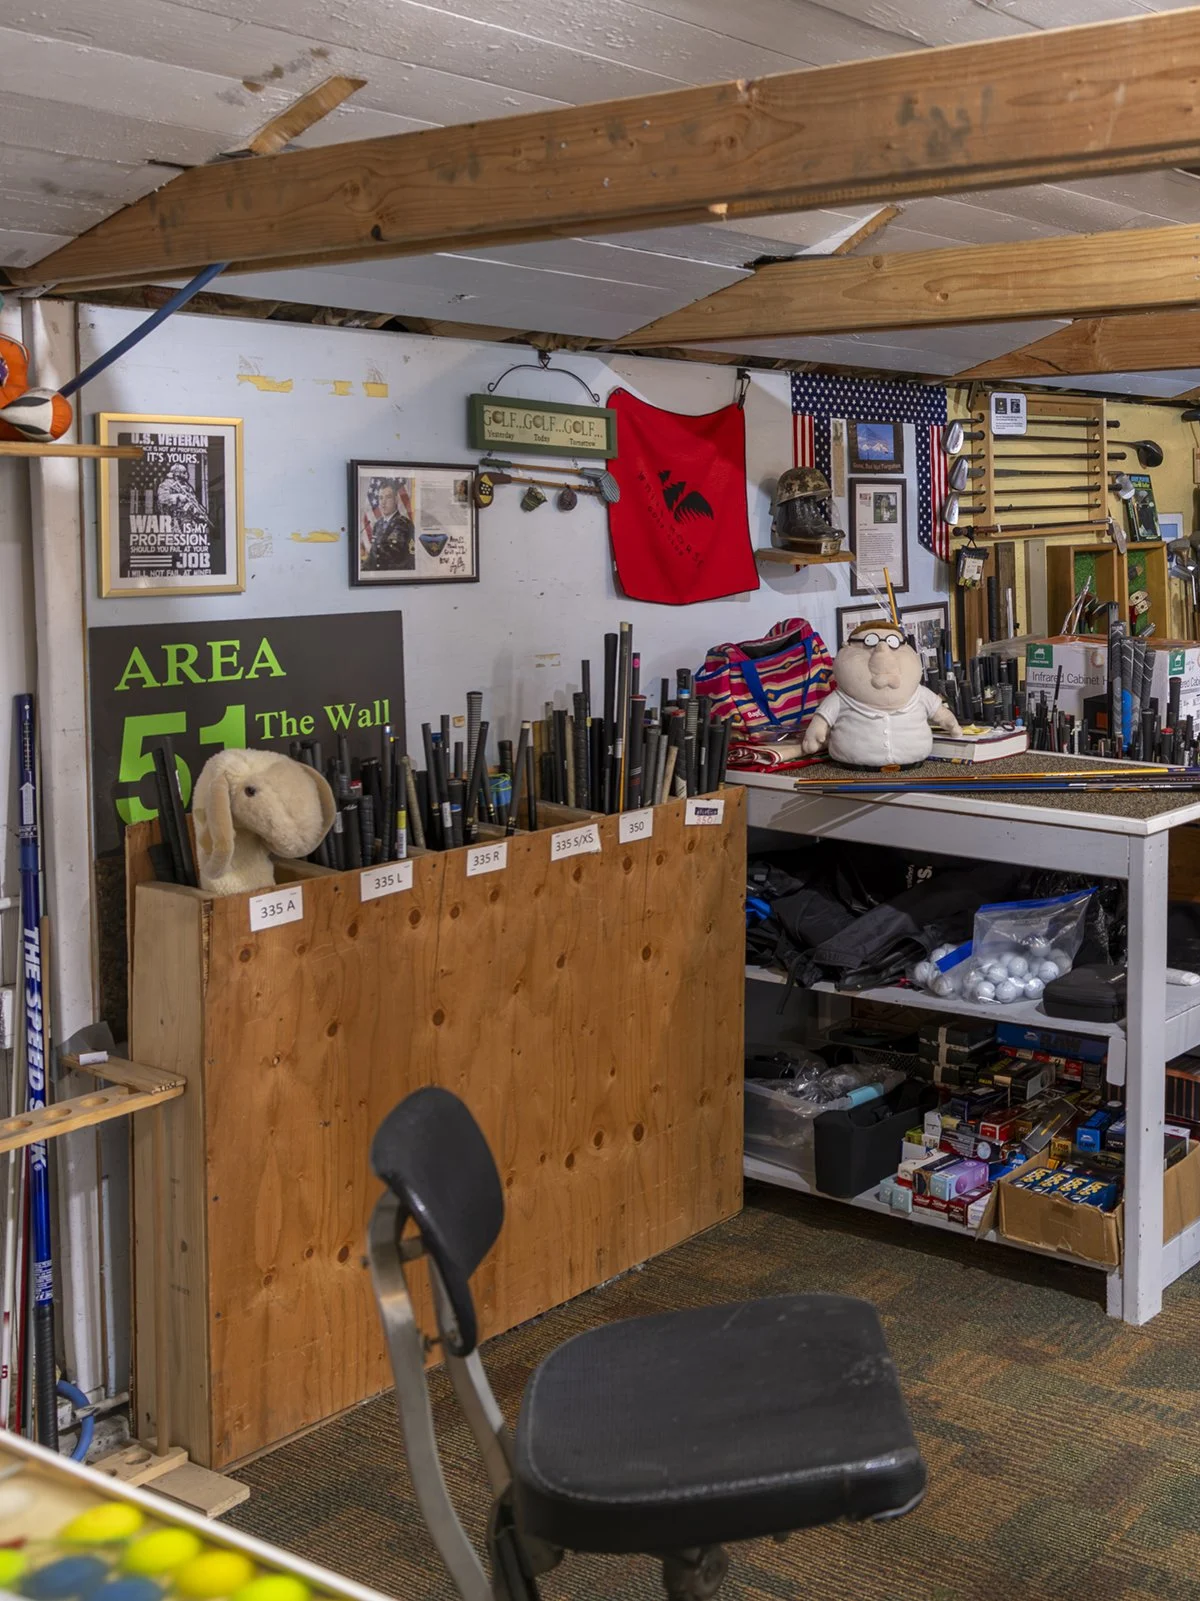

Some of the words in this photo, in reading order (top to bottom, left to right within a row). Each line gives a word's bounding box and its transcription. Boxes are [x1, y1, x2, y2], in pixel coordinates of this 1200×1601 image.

[131, 433, 154, 445] U.S.
[158, 434, 208, 447] VETERAN
[487, 429, 515, 441] Yesterday
[534, 433, 551, 443] Today
[147, 452, 164, 462] IT'S
[167, 453, 200, 464] YOURS.
[130, 515, 172, 534] WAR
[183, 523, 192, 532] IS
[130, 534, 210, 546] PROFESSION.
[176, 553, 211, 569] JOB
[114, 637, 287, 691] AREA
[1032, 671, 1064, 683] Infrared
[1066, 673, 1101, 686] Cabinet
[255, 711, 315, 740] The
[324, 699, 390, 731] Wall
[629, 821, 644, 833] 350
[556, 839, 571, 851] 335
[574, 833, 593, 847] S/XS
[473, 854, 490, 866] 335
[493, 851, 499, 861] R
[374, 874, 394, 889] 335
[397, 873, 402, 883] L
[261, 903, 283, 918] 335
[287, 900, 296, 911] A
[23, 926, 41, 983] THE
[25, 986, 45, 1092] SPEED
[29, 1097, 47, 1166] SK
